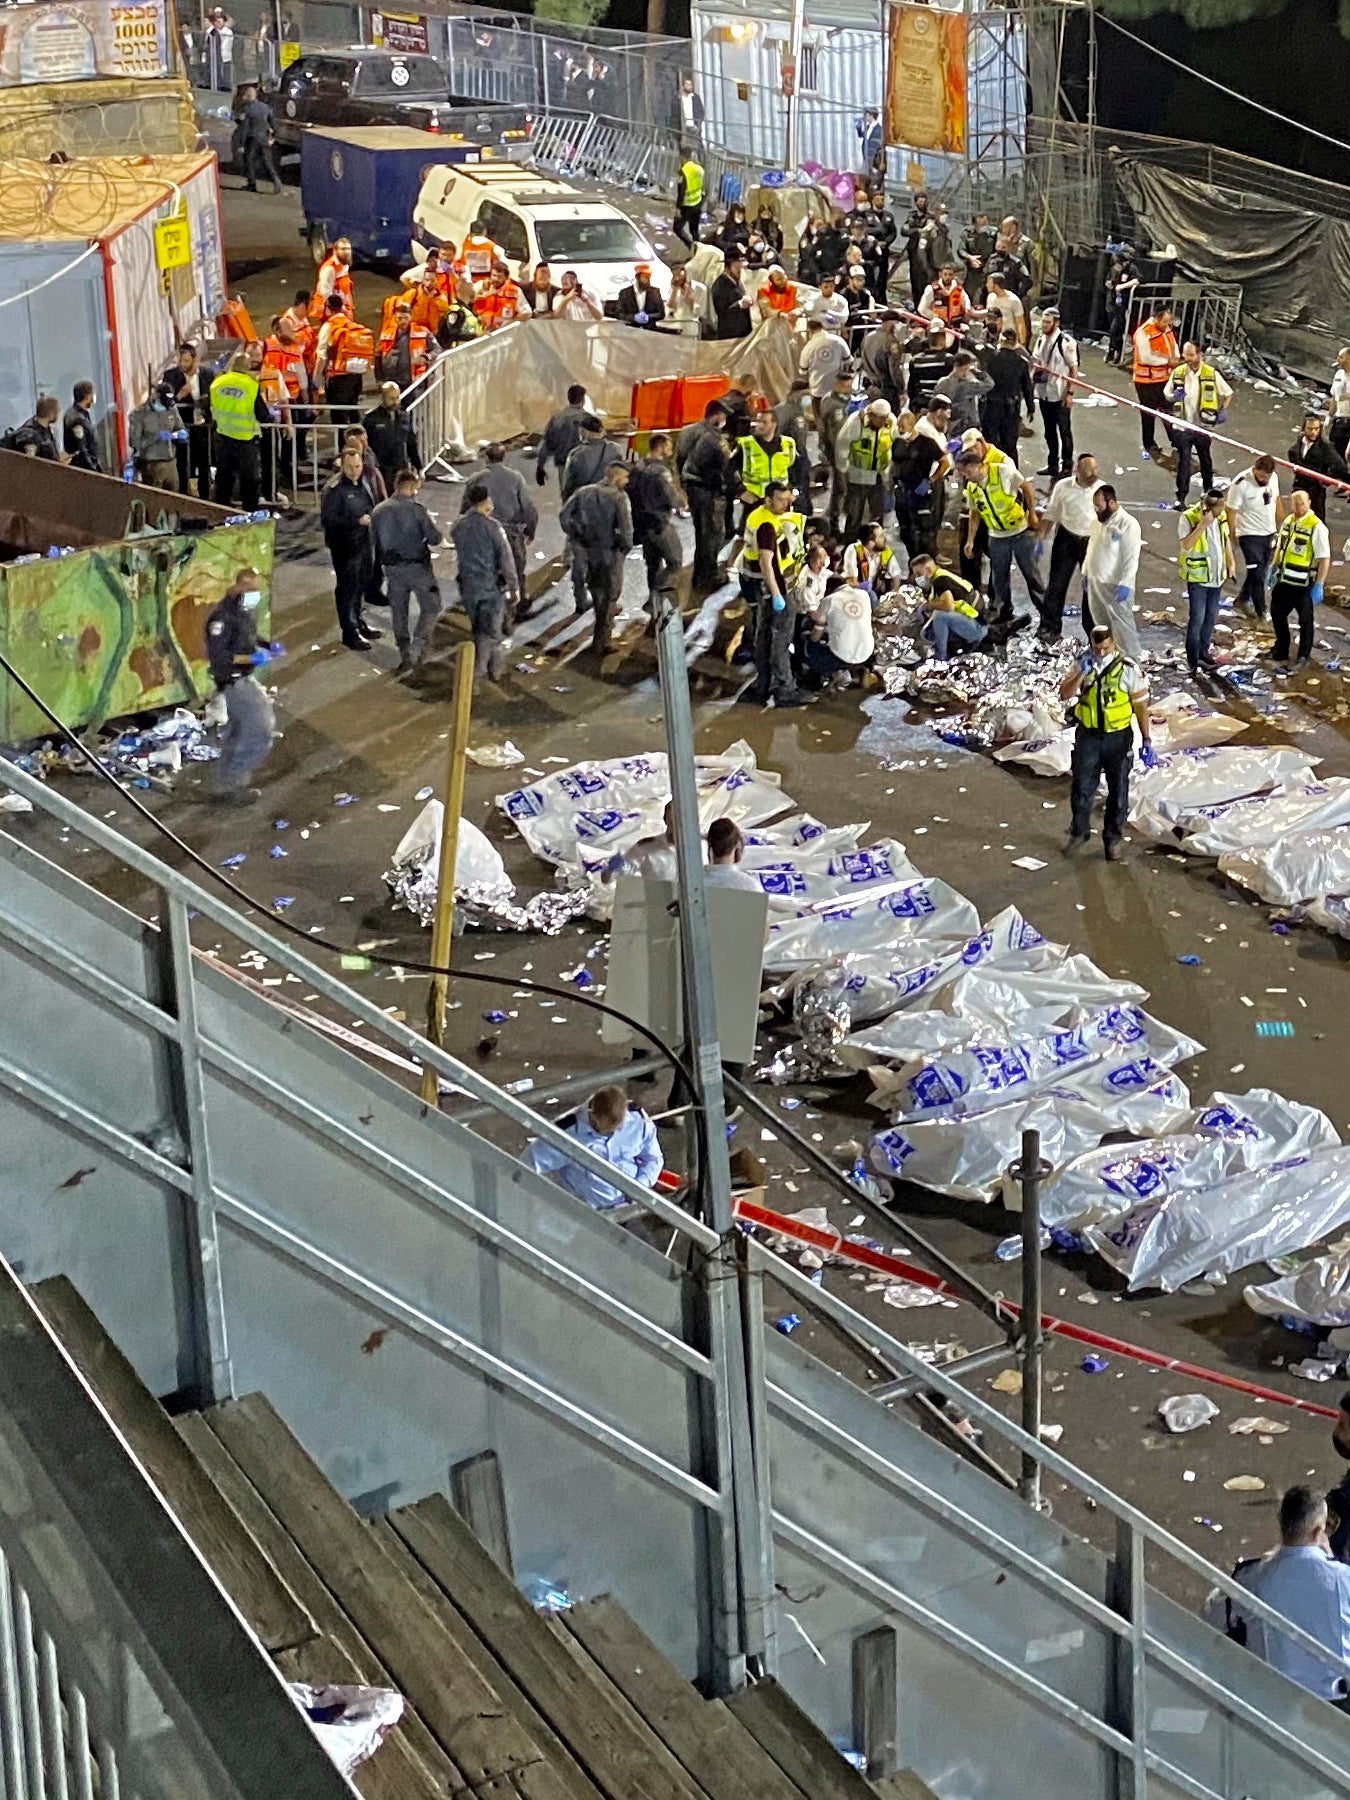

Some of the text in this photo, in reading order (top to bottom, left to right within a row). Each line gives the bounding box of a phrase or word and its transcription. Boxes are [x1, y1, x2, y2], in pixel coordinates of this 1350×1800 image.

[111, 5, 158, 21] מבצע
[116, 23, 156, 39] 1000
[114, 41, 158, 55] סיומי
[113, 58, 161, 72] הזוהר
